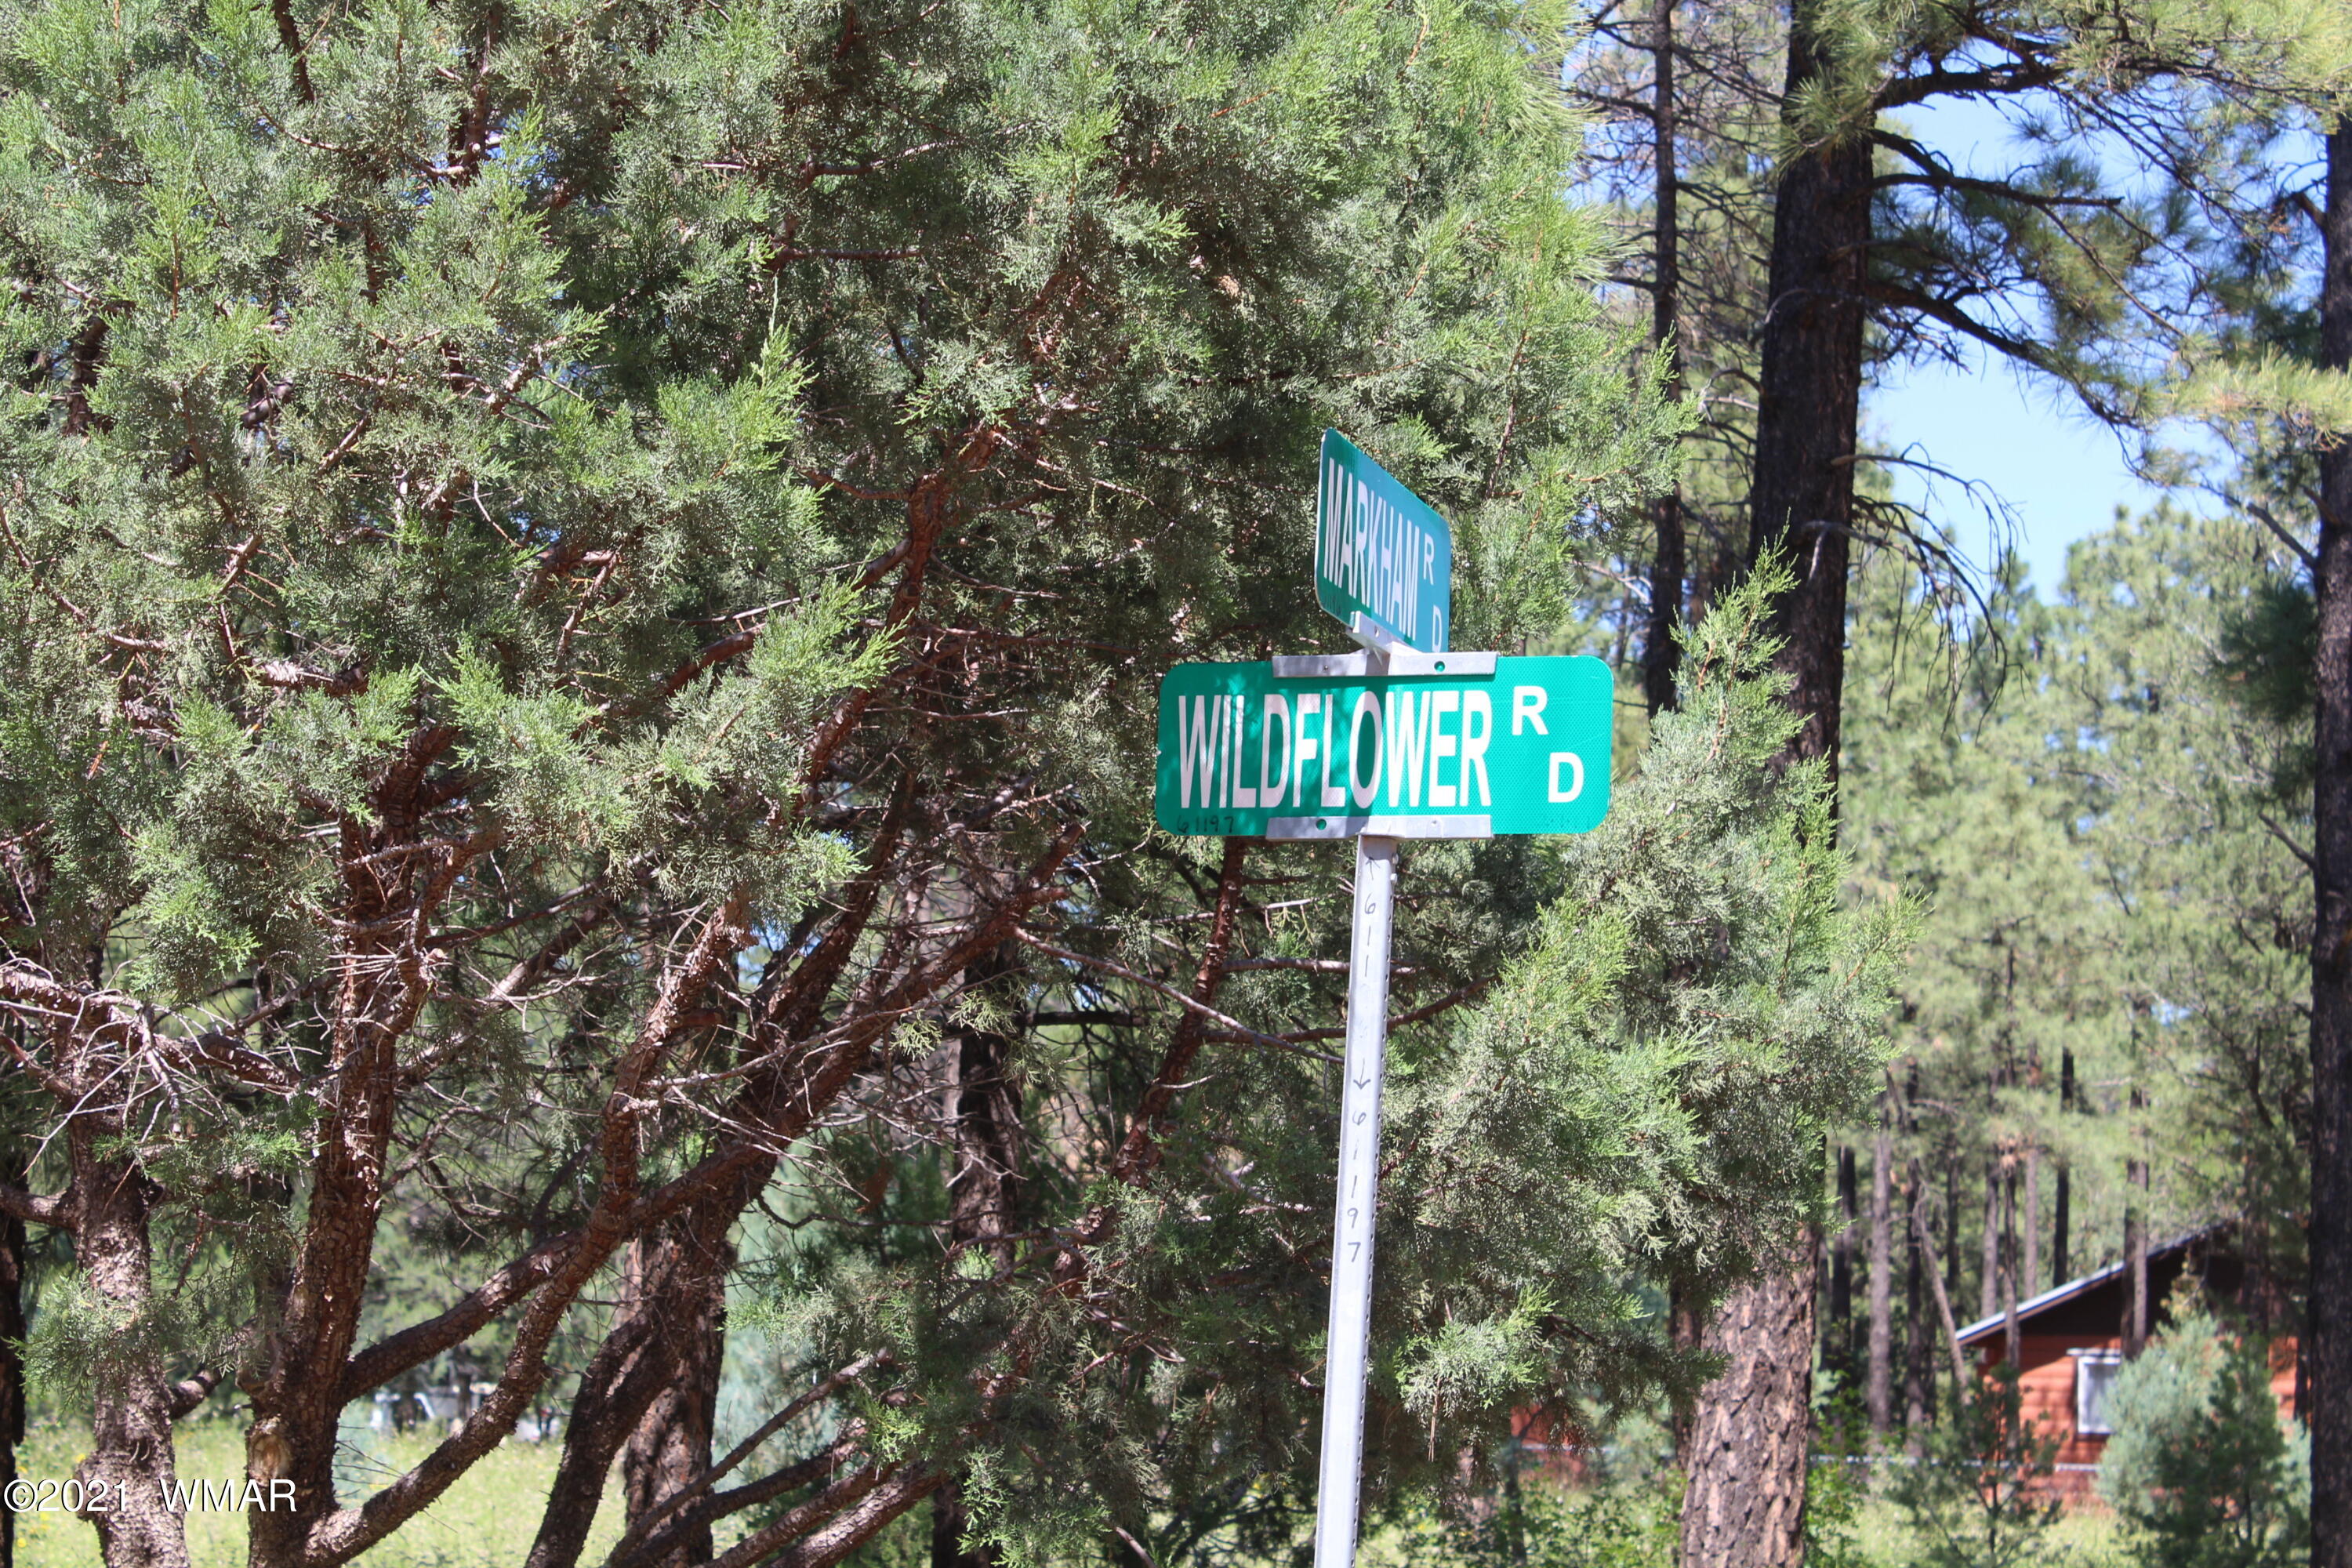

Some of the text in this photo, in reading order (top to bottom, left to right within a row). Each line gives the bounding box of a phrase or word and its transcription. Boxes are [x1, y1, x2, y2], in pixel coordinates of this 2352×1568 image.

[1323, 457, 1420, 641] MARKHAM
[1178, 690, 1491, 808] WILDFLOWER
[1177, 815, 1234, 833] 61197
